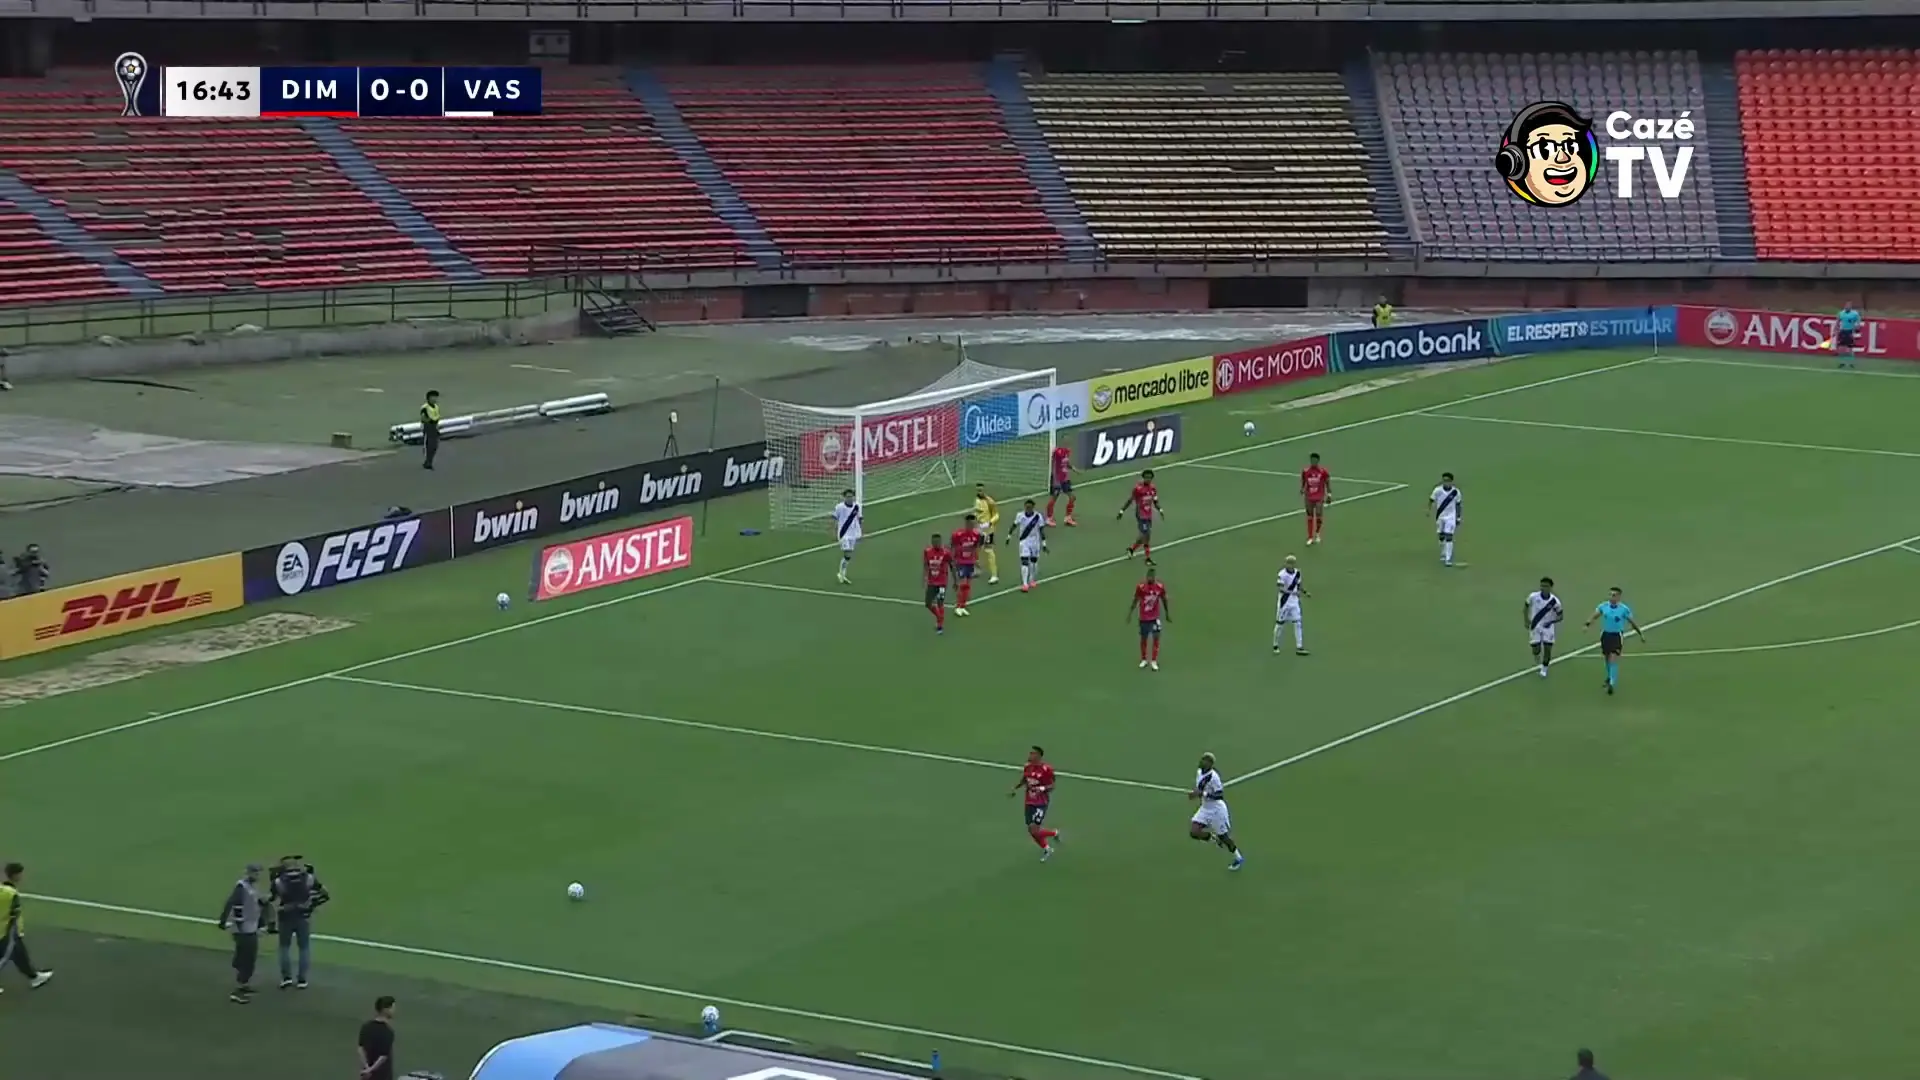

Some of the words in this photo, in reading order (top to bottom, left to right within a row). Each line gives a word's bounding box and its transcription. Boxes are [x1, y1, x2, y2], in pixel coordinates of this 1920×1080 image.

[1349, 338, 1413, 362] ueno
[1418, 325, 1481, 355] bank
[1507, 325, 1524, 342] EL
[1590, 320, 1609, 336] ES
[1238, 356, 1264, 383] MG
[1268, 345, 1324, 378] MOTOR
[1114, 372, 1176, 404] mercado
[1178, 368, 1209, 392] libre
[966, 407, 1012, 440] Midea
[1092, 420, 1174, 466] bwin
[639, 463, 702, 504] bwin
[723, 449, 784, 488] bwin
[473, 500, 539, 543] bwin
[559, 481, 620, 522] bwin
[283, 553, 303, 572] EA
[311, 518, 421, 587] FC27
[575, 524, 688, 586] AMSTEL
[59, 577, 189, 635] DHL
